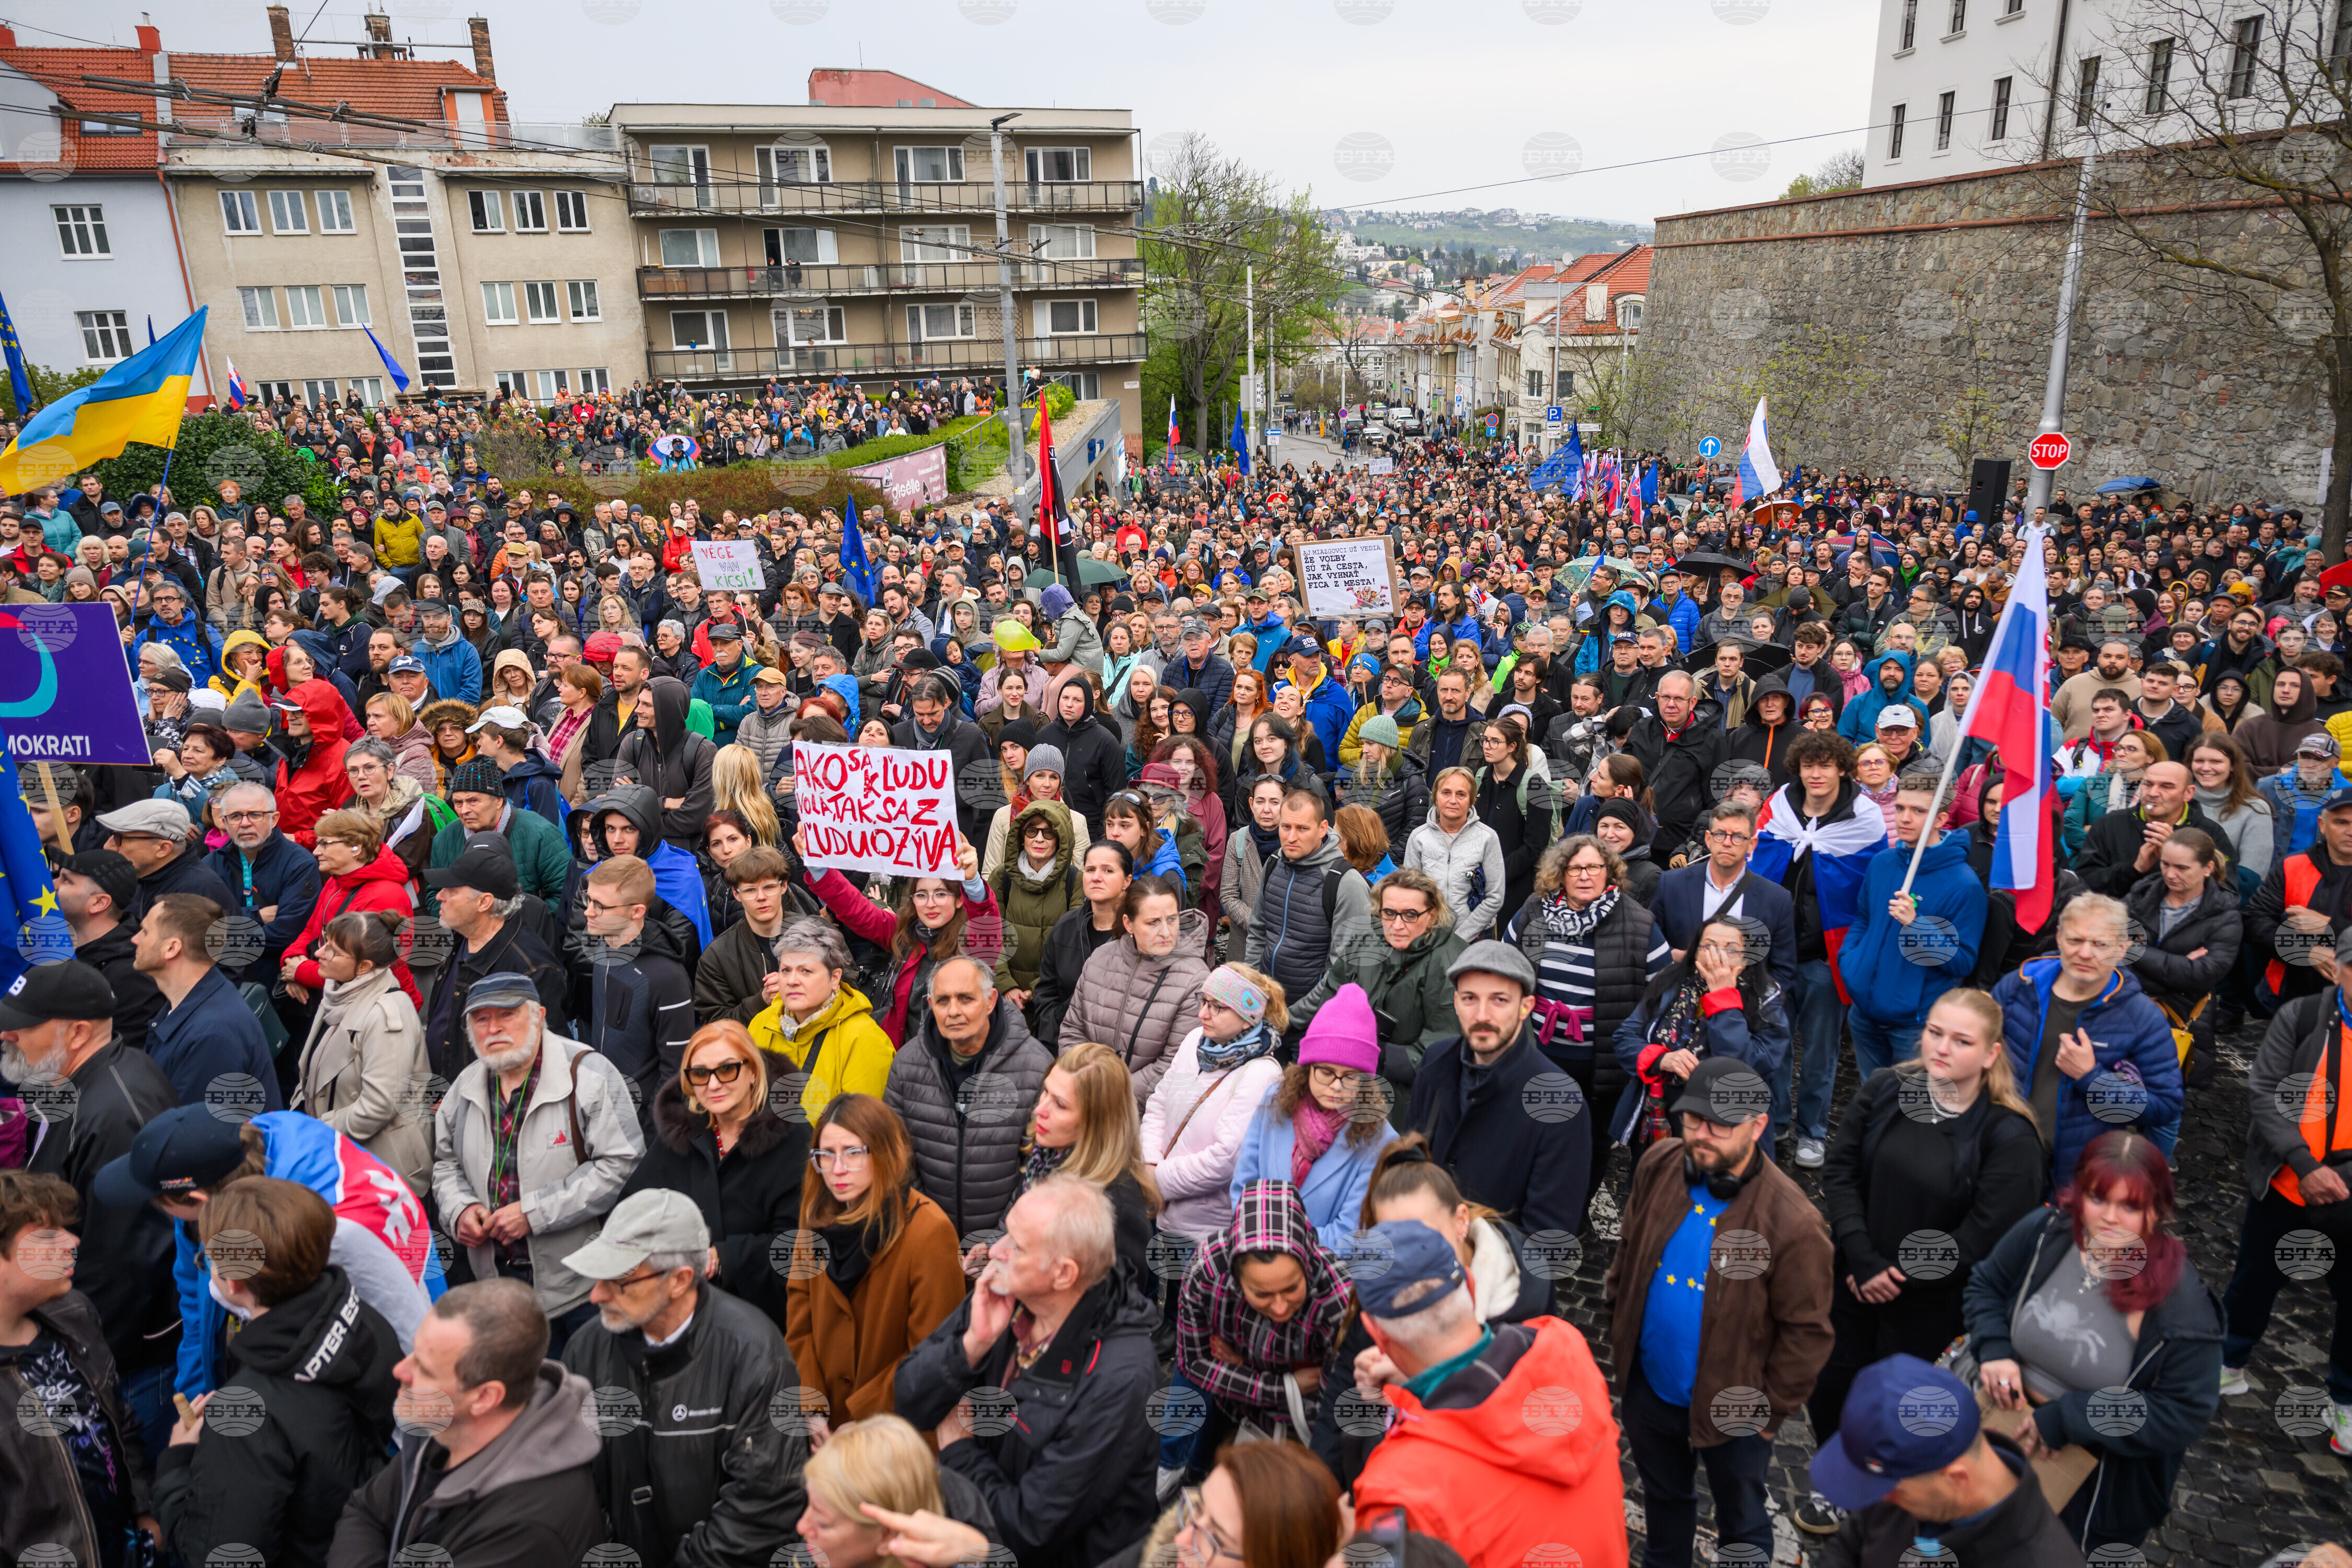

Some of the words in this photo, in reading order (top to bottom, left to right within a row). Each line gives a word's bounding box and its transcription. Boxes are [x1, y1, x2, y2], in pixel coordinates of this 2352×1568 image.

[1549, 408, 1558, 420] P
[2031, 443, 2067, 458] STOP
[700, 545, 734, 559] VÉGE
[1304, 555, 1315, 564] ŽE
[719, 562, 740, 572] VAN
[1306, 563, 1316, 572] SÚ
[1321, 562, 1332, 571] TÁ
[1336, 562, 1368, 570] CESTA,
[1327, 569, 1359, 579] VYHNAŤ
[1344, 578, 1376, 586] MESTA!
[795, 748, 848, 791] AKO
[847, 748, 872, 771] SA
[863, 769, 881, 799] K
[883, 754, 948, 791] ĽUDU
[876, 798, 910, 823] SA
[910, 799, 940, 826] Z
